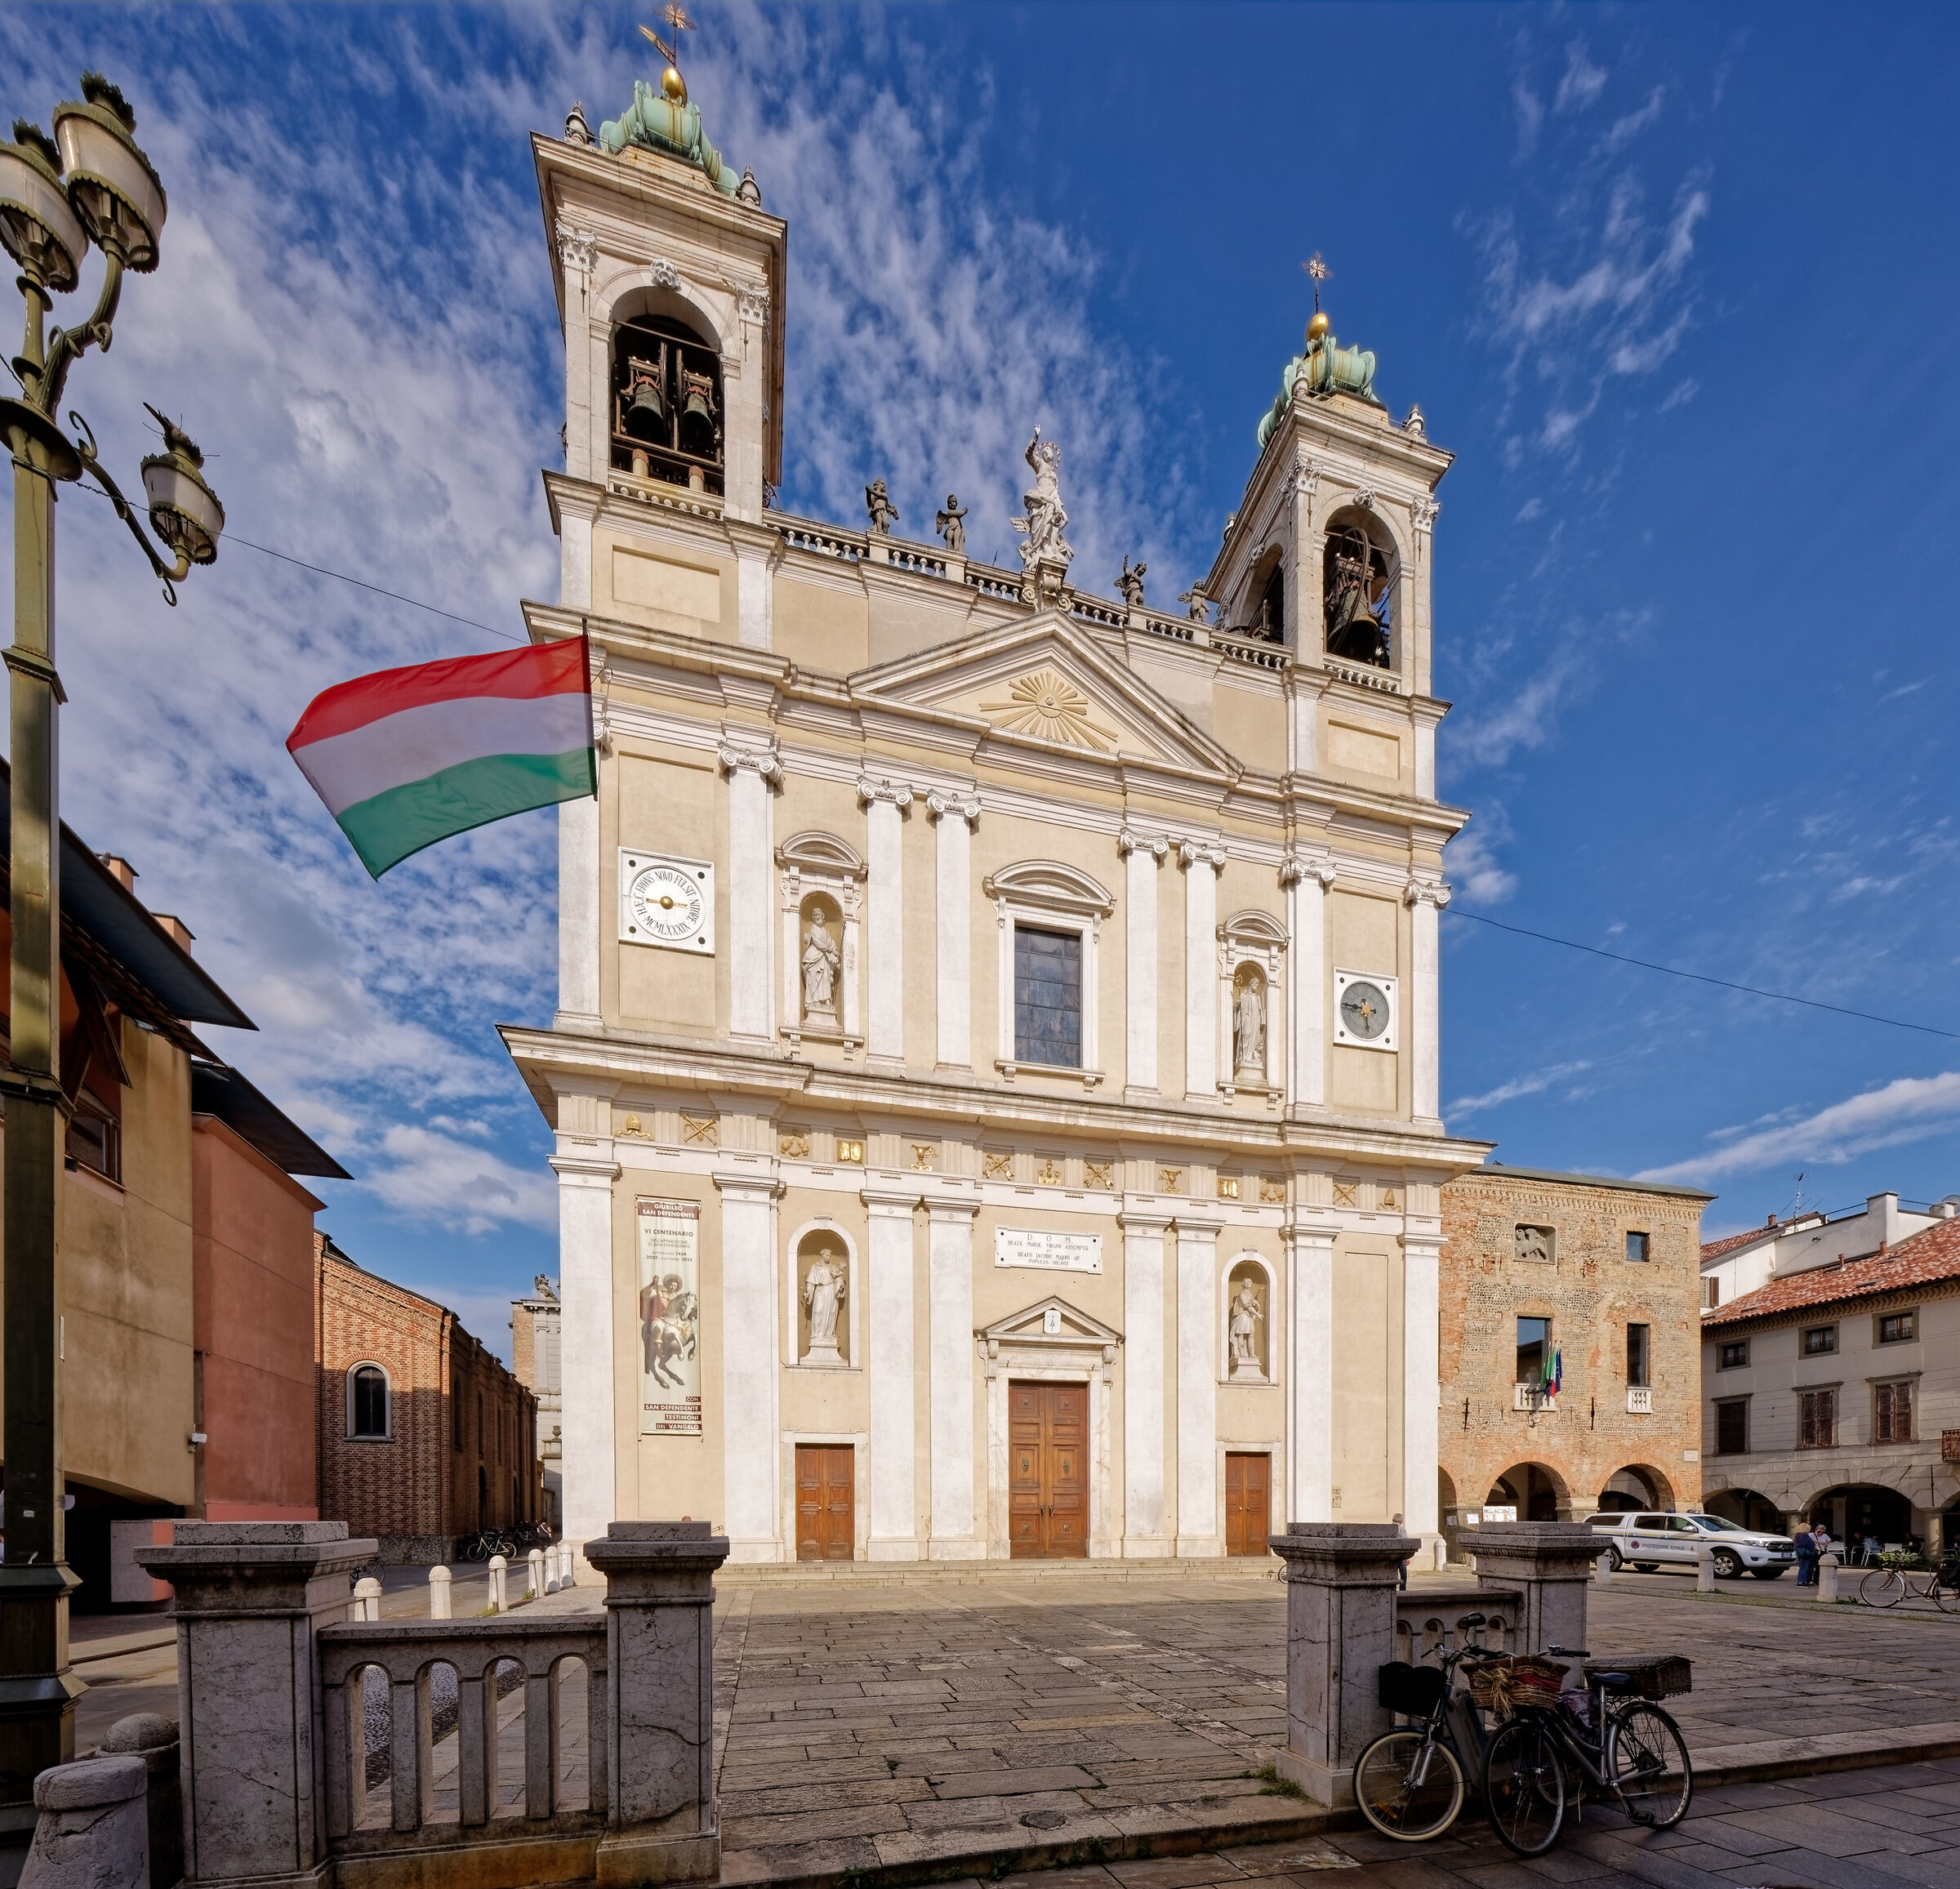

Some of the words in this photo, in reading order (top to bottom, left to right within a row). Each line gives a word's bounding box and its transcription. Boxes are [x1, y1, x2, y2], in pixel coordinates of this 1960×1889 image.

[635, 873, 656, 893] FRONS
[654, 871, 673, 882] NOVO
[674, 875, 697, 897] FULSIT
[686, 899, 701, 924] NITORE
[643, 916, 691, 936] MCMLXXXIX
